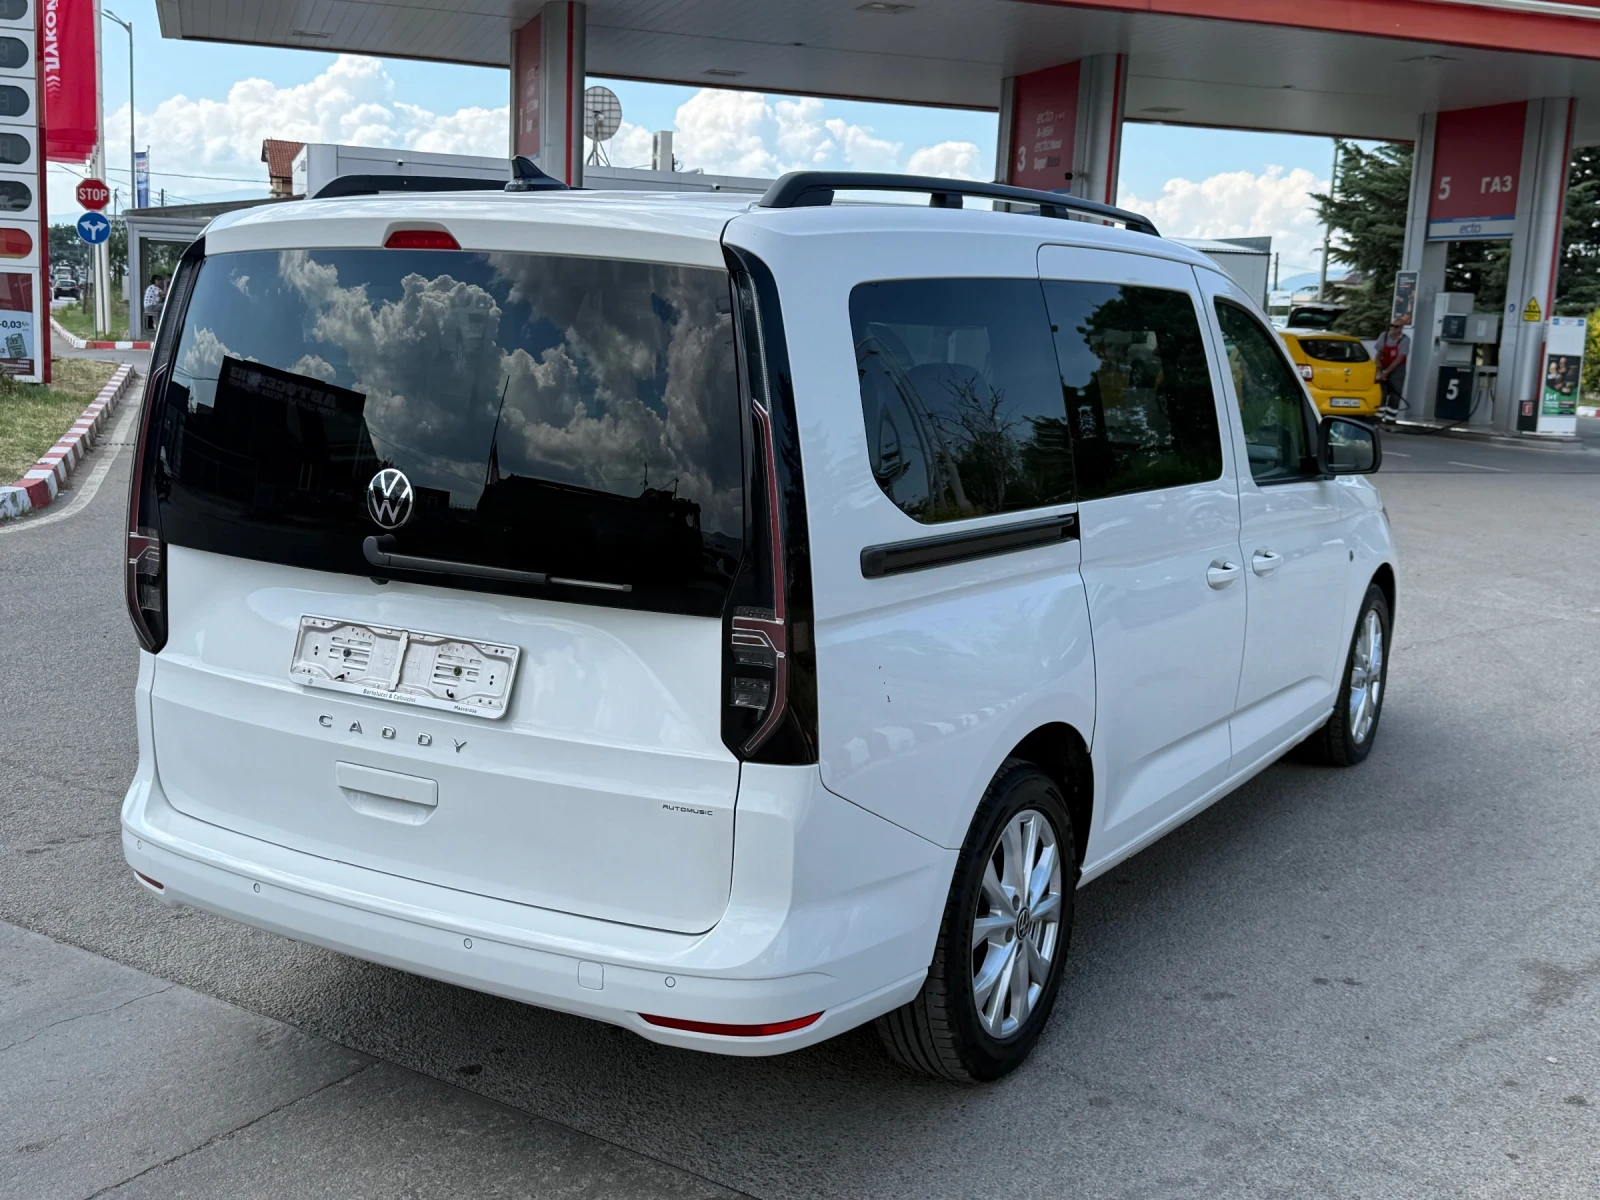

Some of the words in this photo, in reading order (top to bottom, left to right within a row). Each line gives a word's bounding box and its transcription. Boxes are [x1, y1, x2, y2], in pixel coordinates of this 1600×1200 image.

[1017, 146, 1026, 172] 3
[79, 188, 108, 201] STOP
[1437, 176, 1452, 200] 5
[1480, 175, 1513, 194] ГАЗ
[1459, 223, 1482, 234] ecto
[1446, 379, 1459, 400] 5
[318, 713, 467, 753] CADDY
[663, 804, 713, 816] AUTOMUSIC
